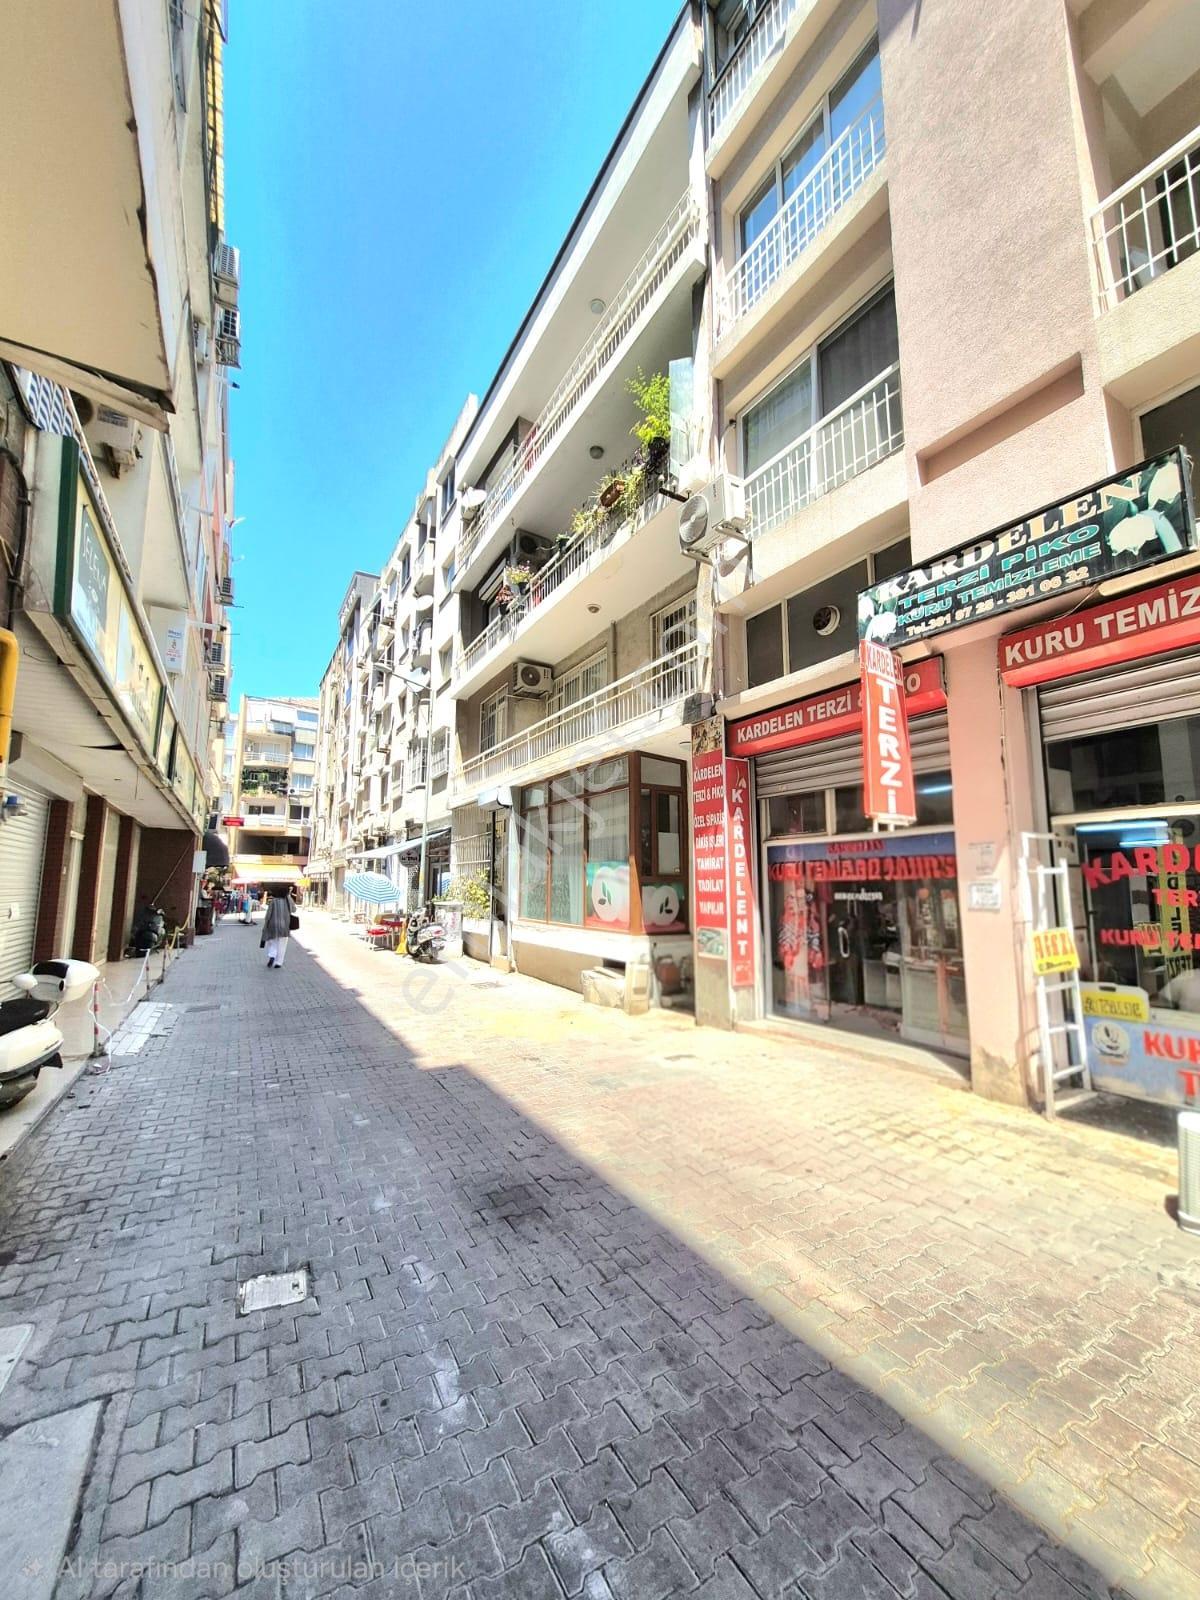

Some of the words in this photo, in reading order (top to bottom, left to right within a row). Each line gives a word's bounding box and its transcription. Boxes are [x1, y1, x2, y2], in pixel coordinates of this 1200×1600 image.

[875, 474, 1145, 602] KARDELEN
[898, 565, 990, 610] TERZİ
[1002, 524, 1100, 572] PİKO
[896, 596, 952, 627] KURU
[957, 542, 1102, 600] TEMİZLEME
[867, 643, 903, 682] KARDELEN
[1005, 622, 1085, 666] KURU
[737, 709, 803, 743] KARDELEN
[807, 691, 851, 722] TERZİ
[876, 679, 903, 815] TERZİ
